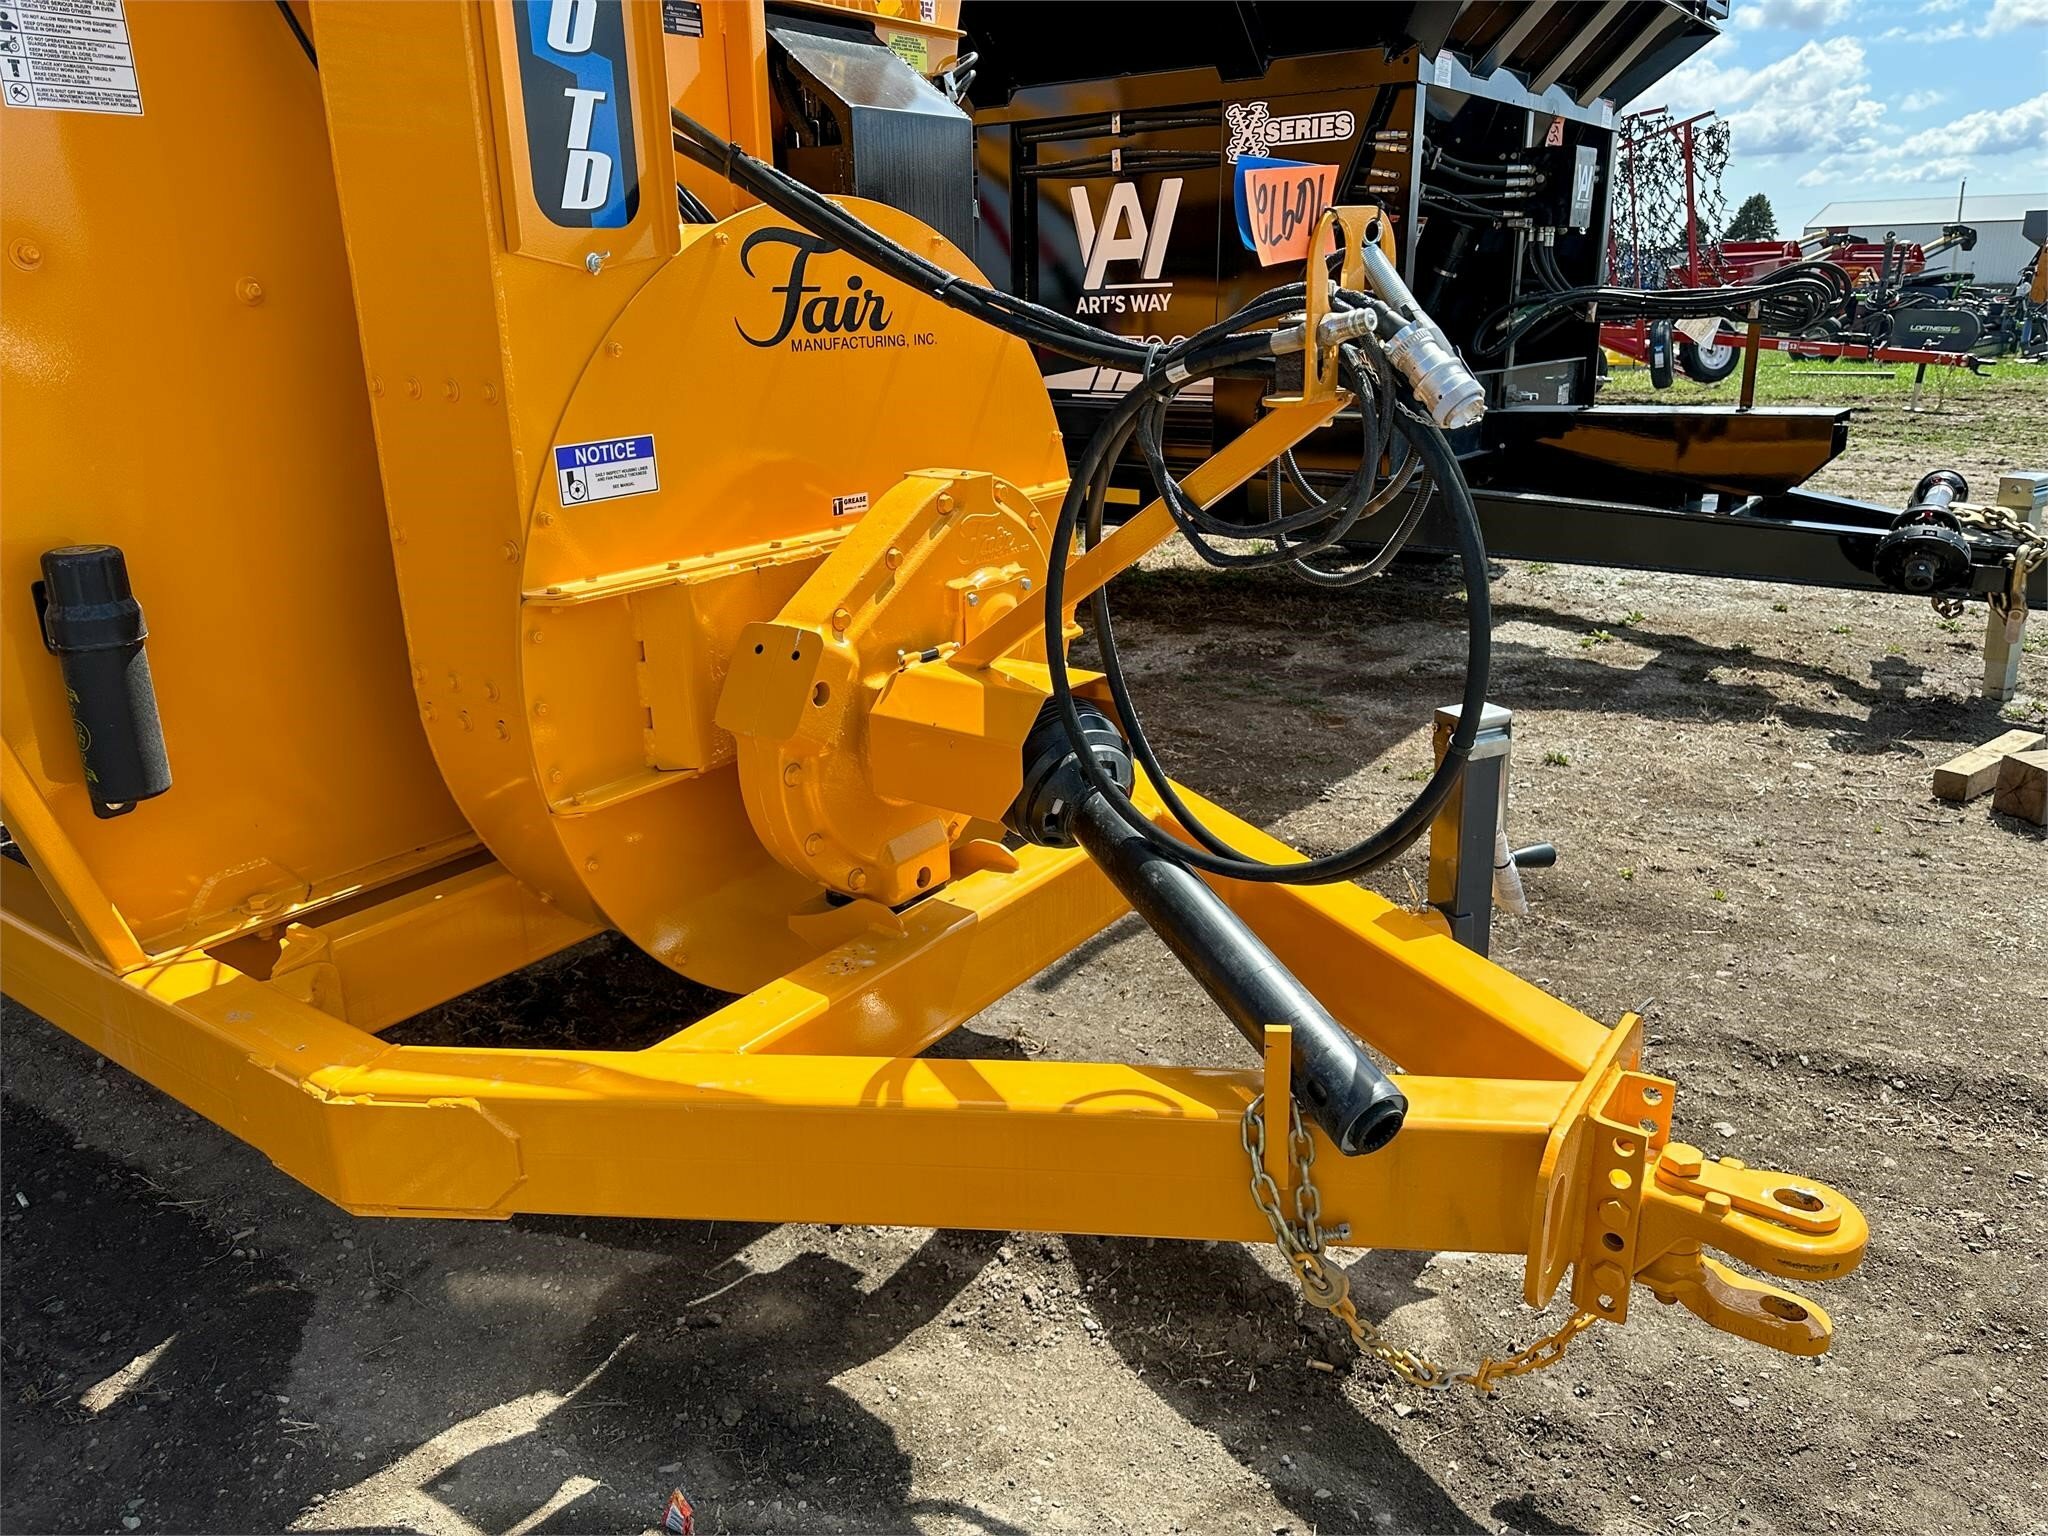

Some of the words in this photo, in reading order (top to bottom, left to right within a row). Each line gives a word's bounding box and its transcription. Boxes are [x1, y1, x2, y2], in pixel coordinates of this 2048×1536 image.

[1265, 114, 1352, 143] SERIES
[735, 227, 893, 347] Fair
[1076, 296, 1125, 314] ART'S
[1130, 293, 1172, 312] WAY
[791, 335, 909, 352] MANUFACTURING,
[914, 333, 937, 345] INC.
[575, 442, 636, 465] NOTICE
[844, 496, 866, 505] GREASE
